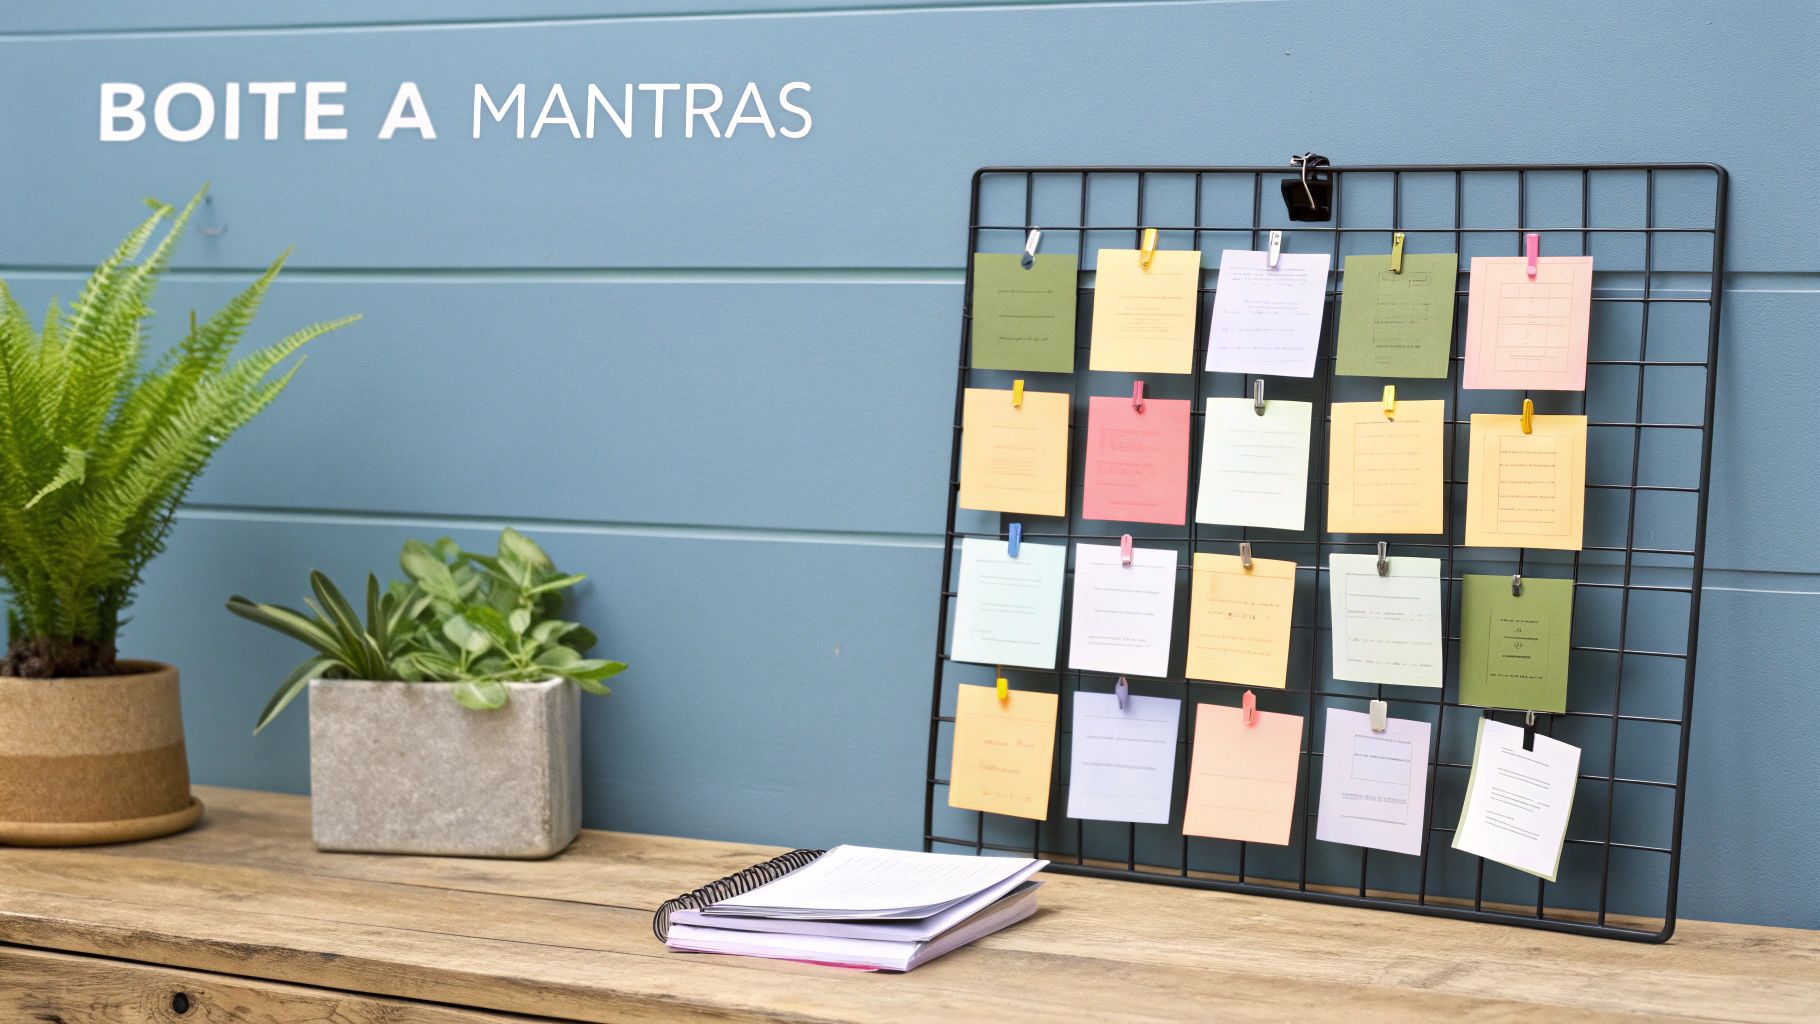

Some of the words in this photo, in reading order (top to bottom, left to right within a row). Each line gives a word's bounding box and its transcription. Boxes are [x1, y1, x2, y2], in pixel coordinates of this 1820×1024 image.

[100, 81, 348, 141] BOITE
[378, 82, 437, 139] A
[472, 81, 812, 138] MANTRAS
